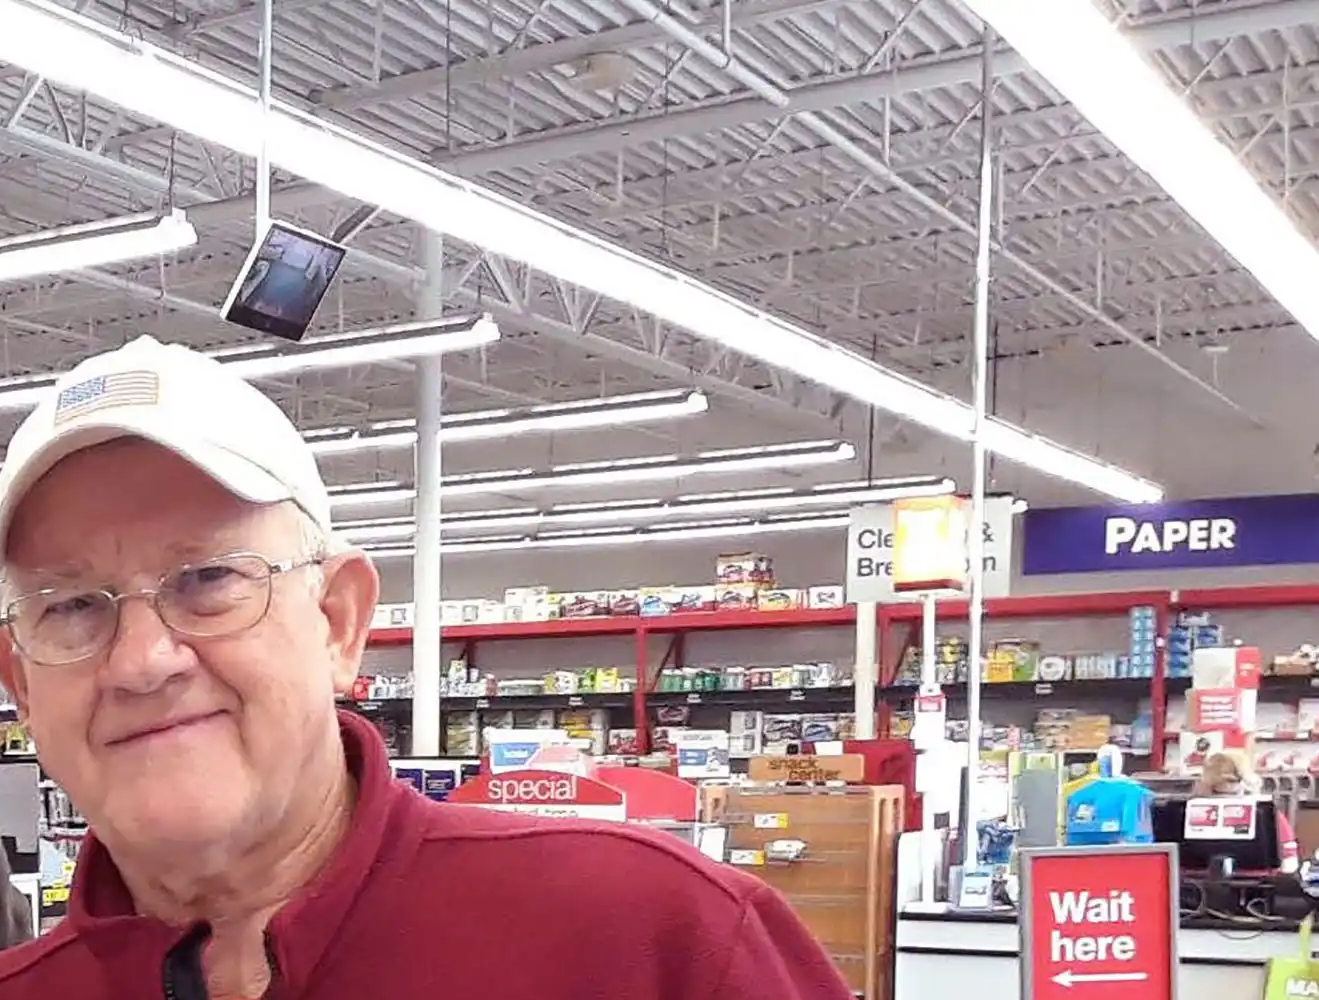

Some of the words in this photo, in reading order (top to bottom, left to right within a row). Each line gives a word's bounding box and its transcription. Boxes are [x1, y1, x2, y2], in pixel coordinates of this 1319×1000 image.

[1105, 517, 1237, 554] PAPER
[487, 775, 578, 804] special
[1049, 890, 1136, 925] Wait
[1050, 930, 1137, 963] here
